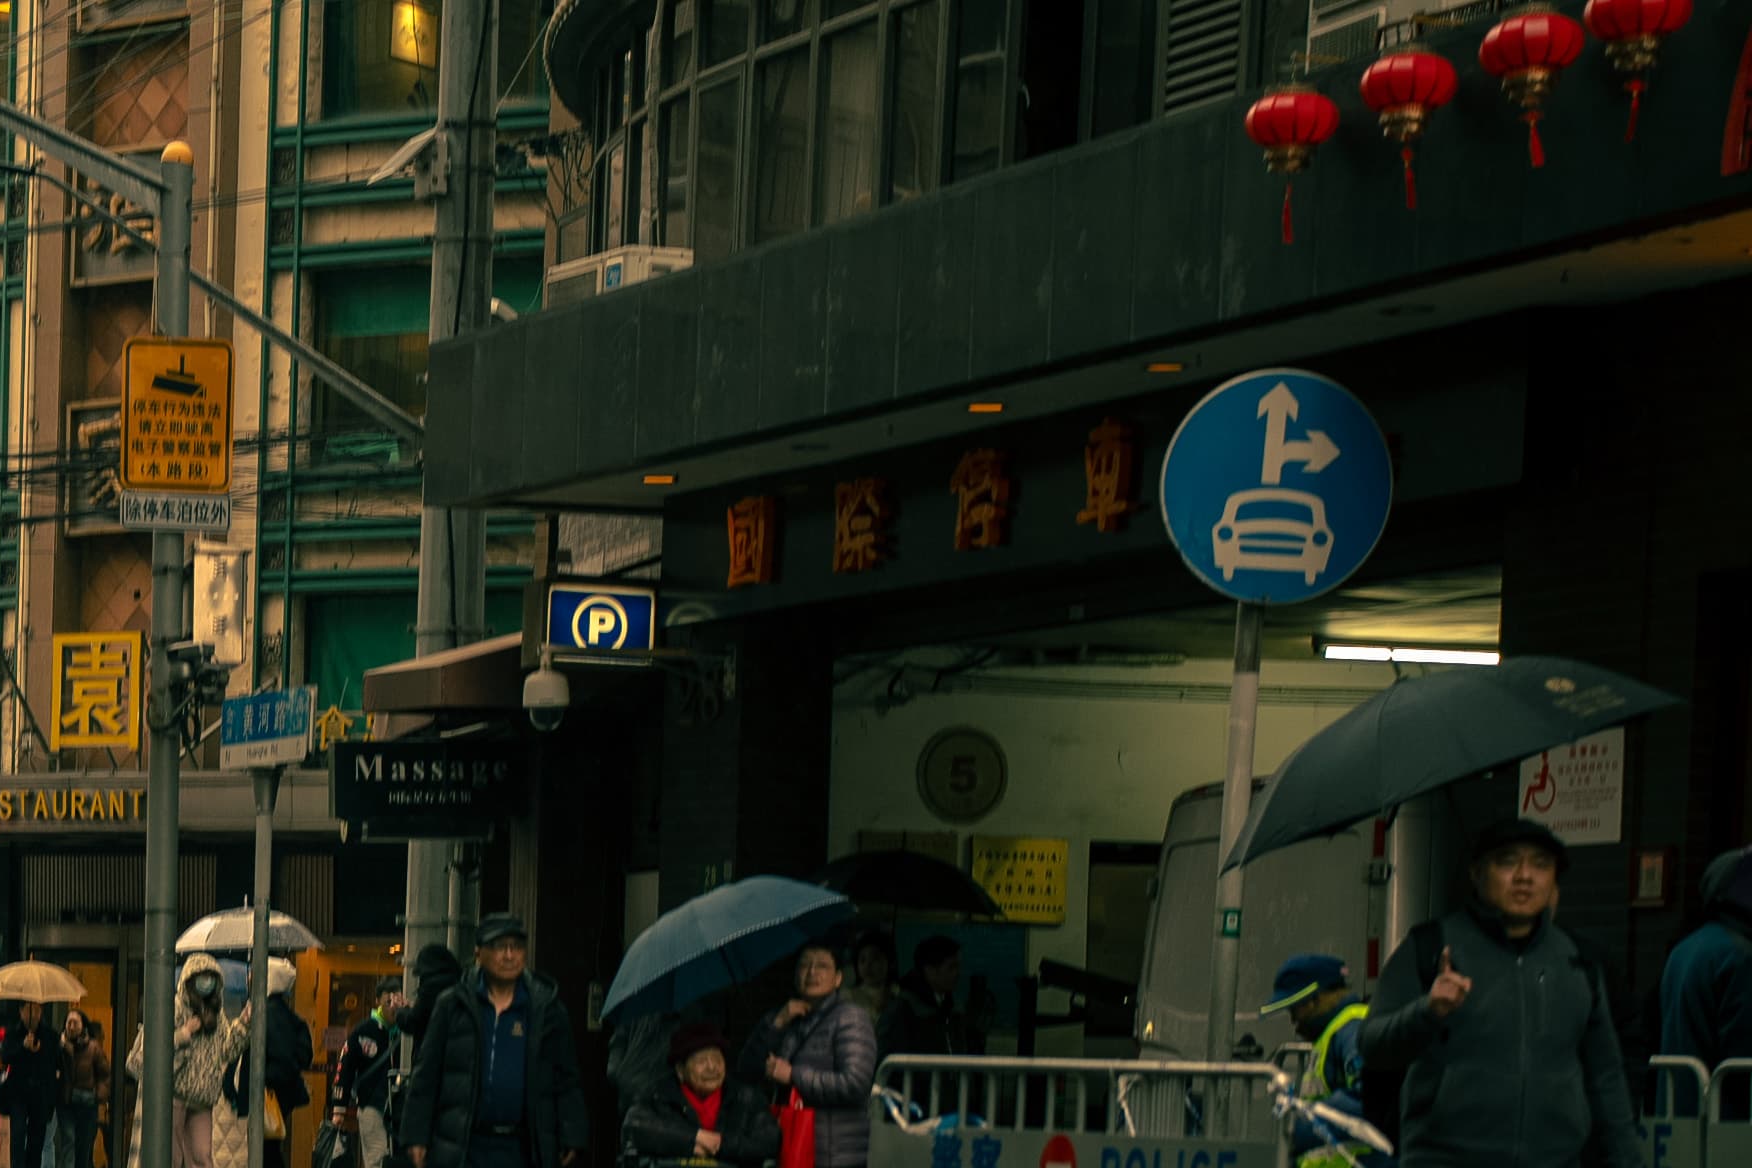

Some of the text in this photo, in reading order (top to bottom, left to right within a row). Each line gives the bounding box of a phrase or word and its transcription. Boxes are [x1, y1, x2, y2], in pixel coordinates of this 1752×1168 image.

[127, 497, 226, 523] 除停车泊位外
[355, 753, 508, 788] Massage
[951, 754, 976, 793] 5
